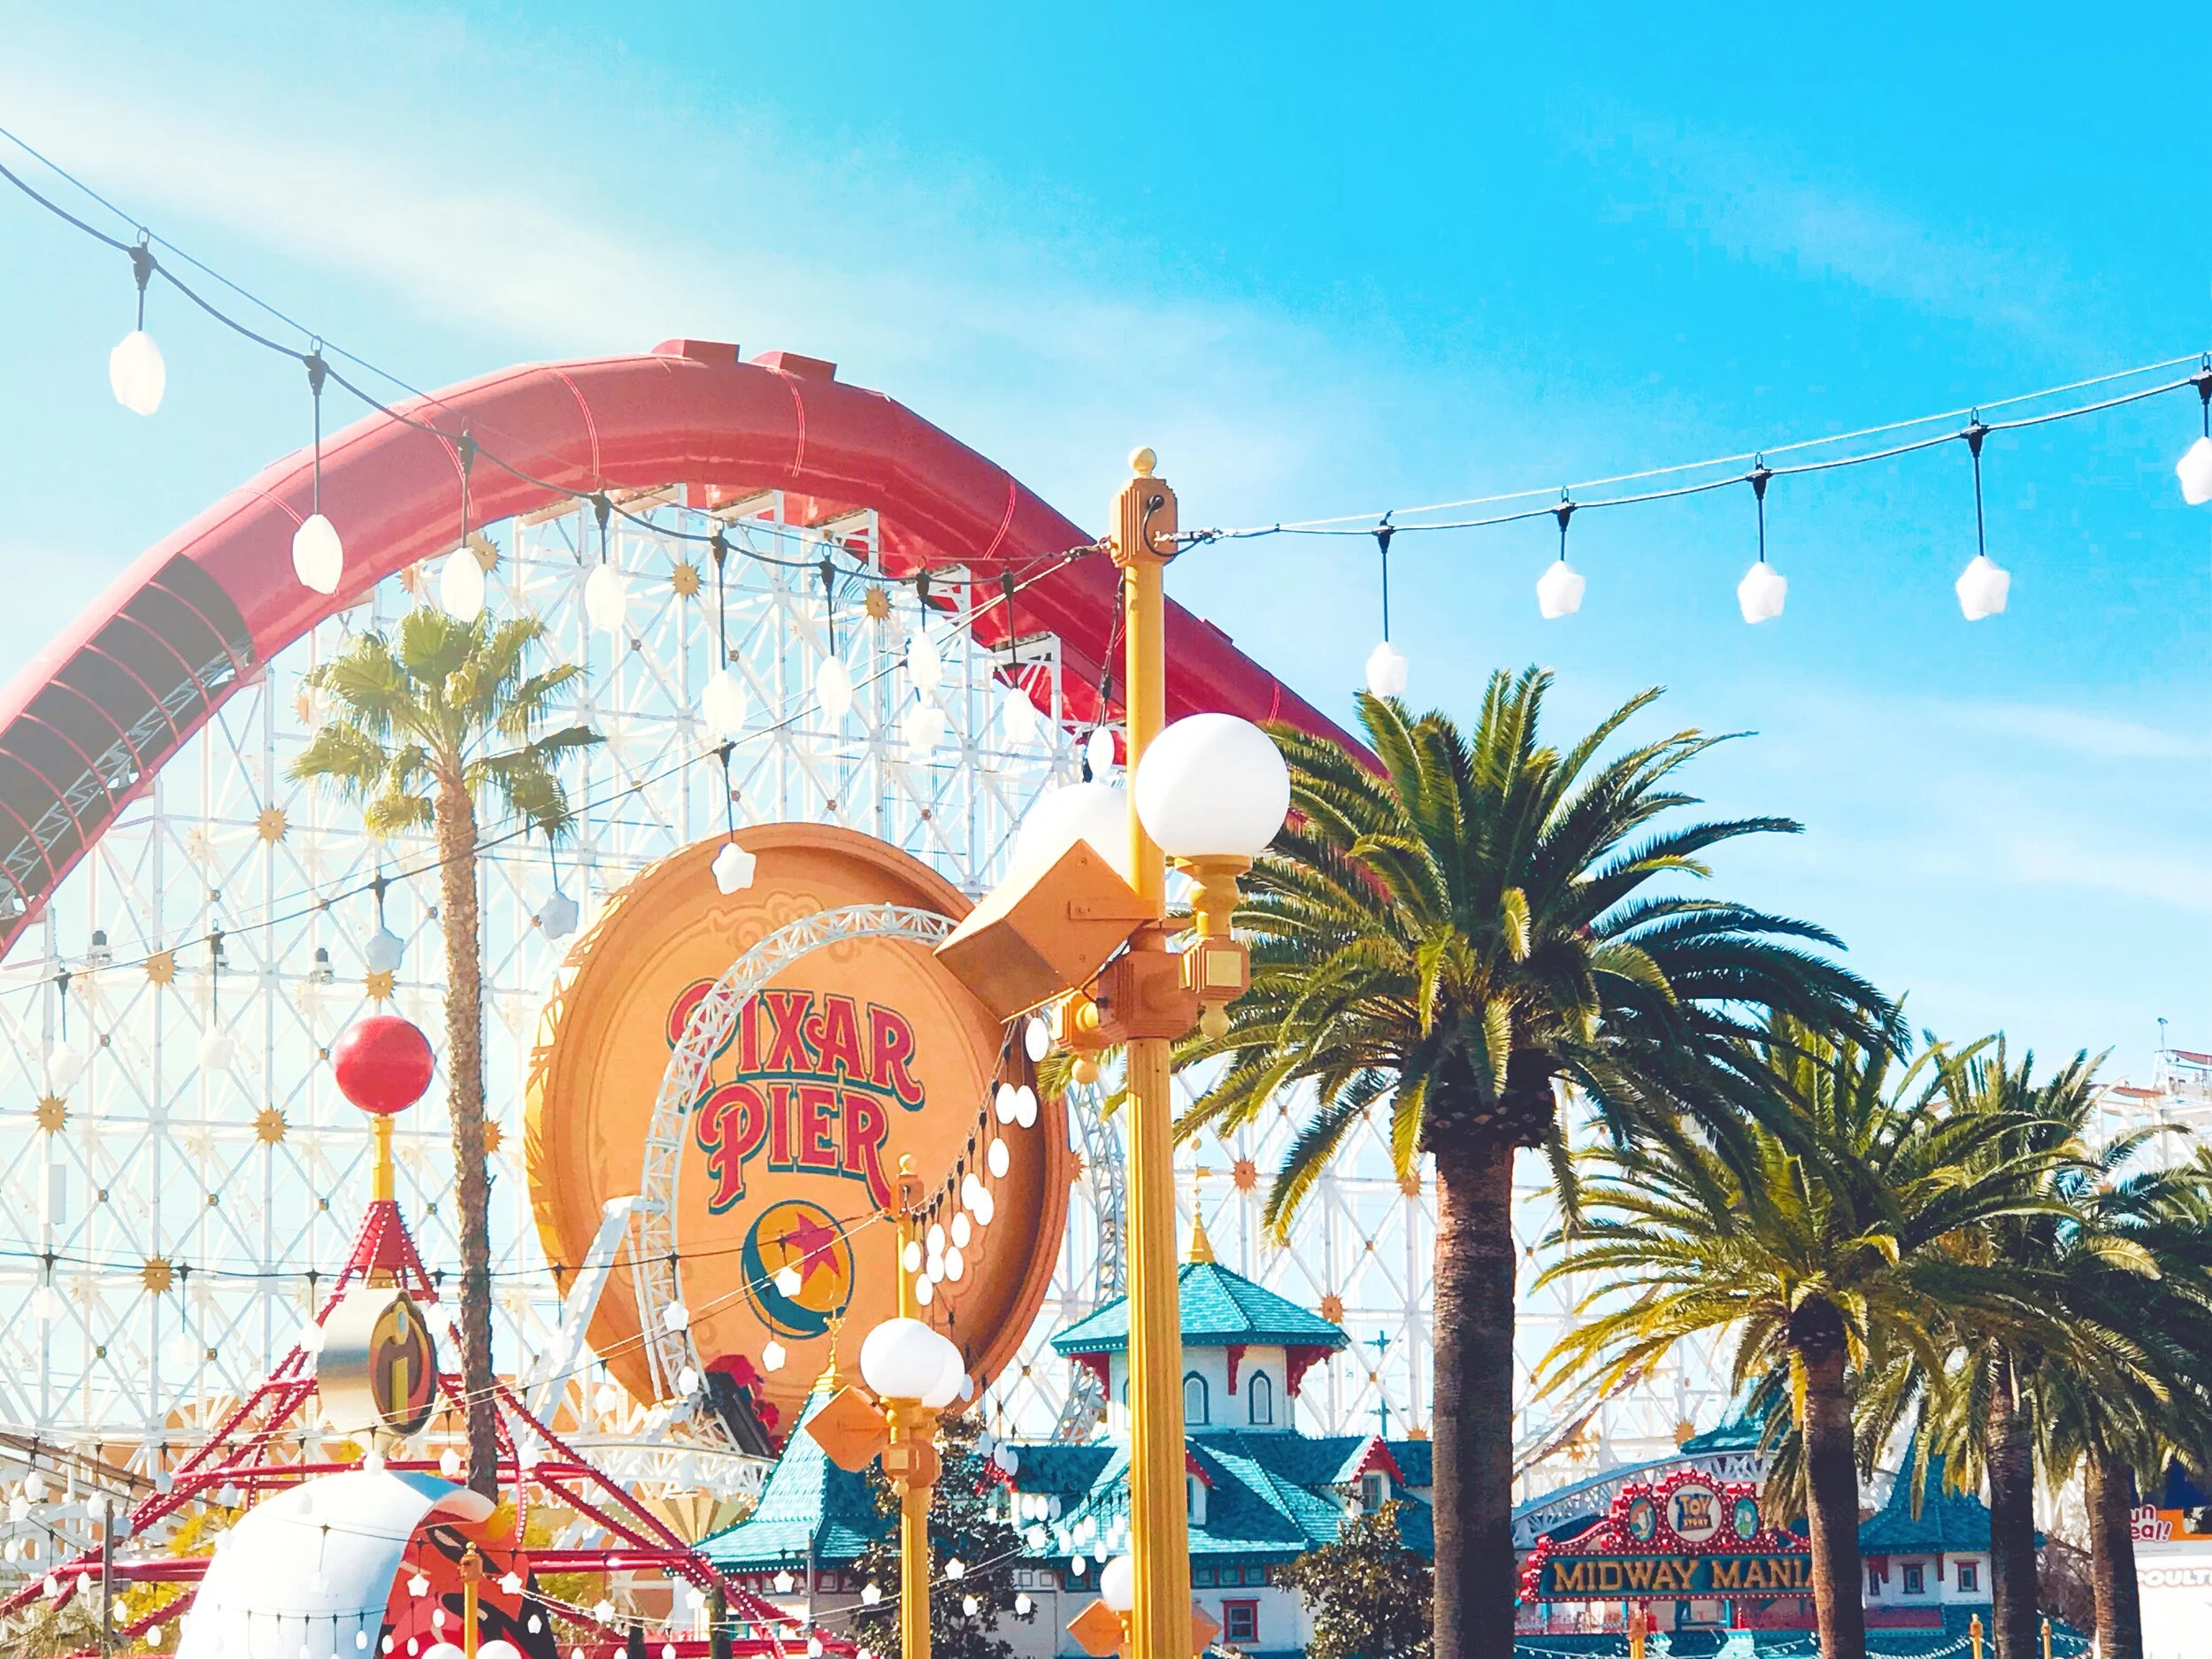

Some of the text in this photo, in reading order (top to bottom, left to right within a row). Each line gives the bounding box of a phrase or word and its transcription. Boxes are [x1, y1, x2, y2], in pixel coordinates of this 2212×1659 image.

[666, 978, 926, 1113] PIXAR
[695, 1080, 896, 1222] PIER
[2131, 1505, 2155, 1524] un
[2131, 1521, 2172, 1541] eal!
[1554, 1559, 1699, 1592] MIDWAY
[2136, 1567, 2212, 1587] OULT
